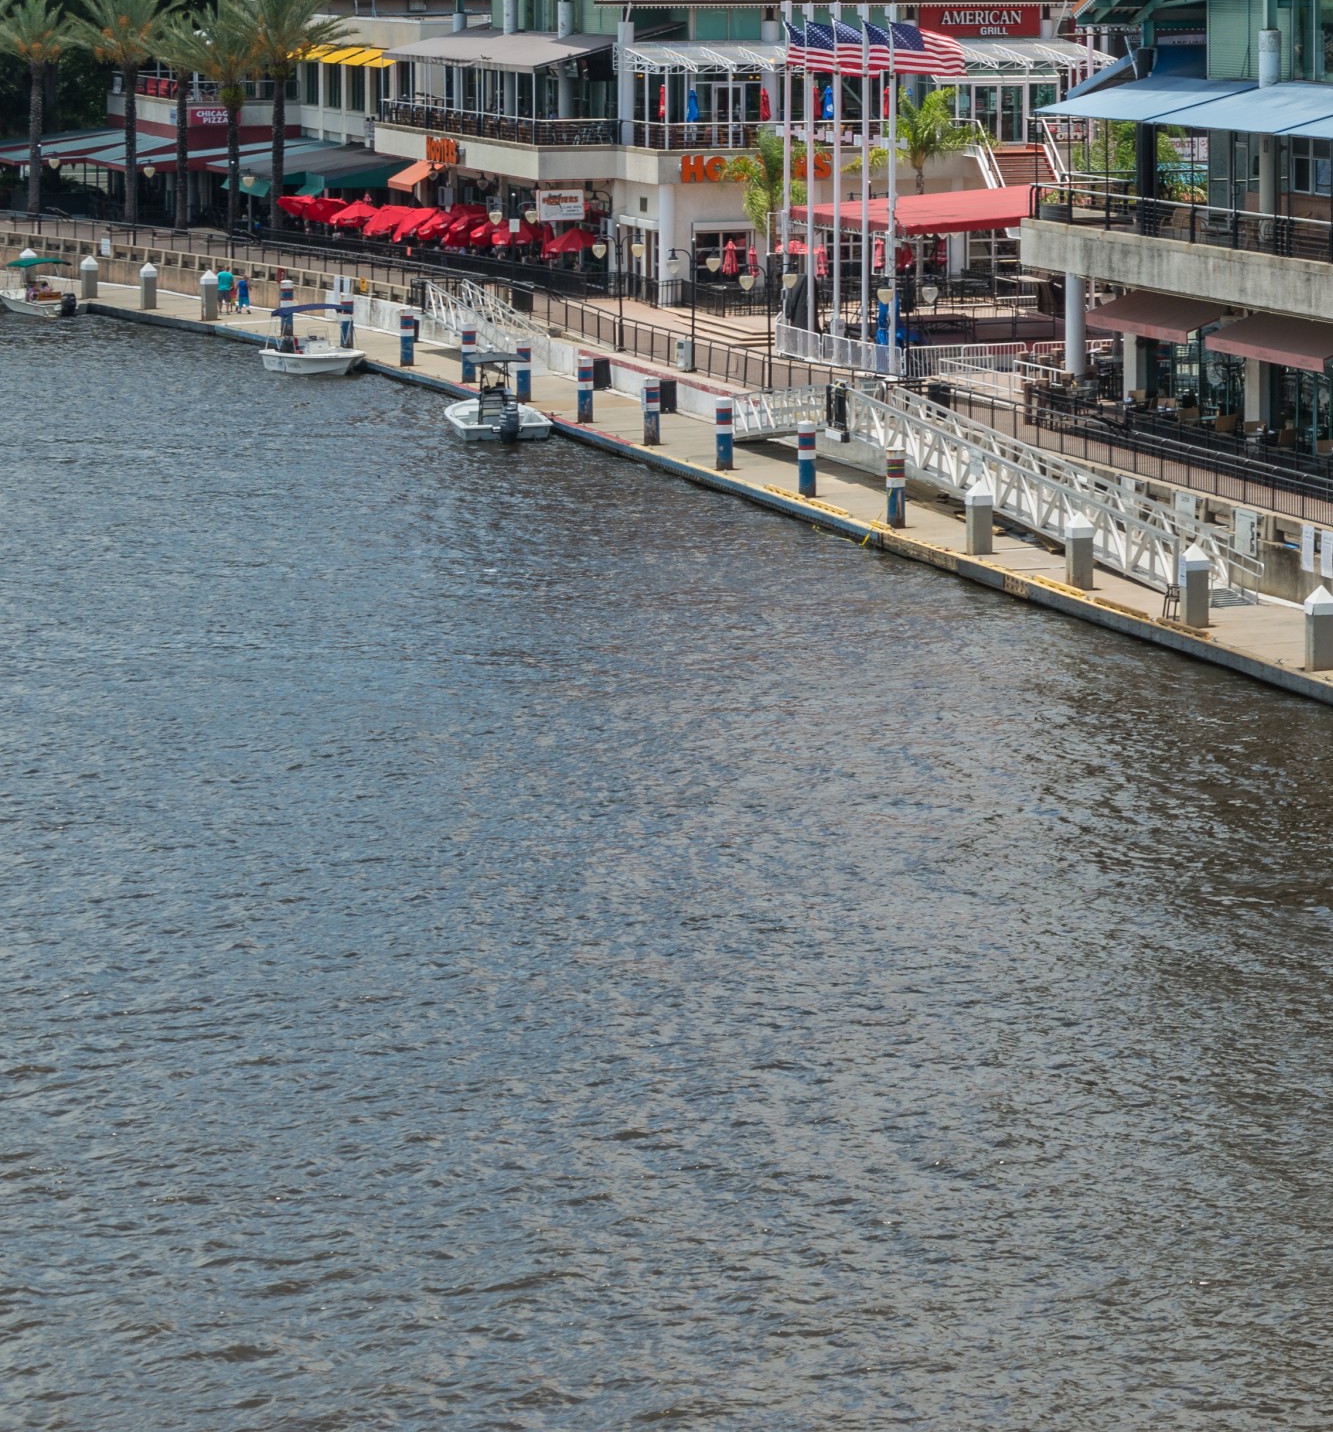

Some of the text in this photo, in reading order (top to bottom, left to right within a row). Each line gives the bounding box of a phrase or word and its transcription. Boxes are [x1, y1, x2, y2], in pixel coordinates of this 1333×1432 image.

[941, 10, 1022, 25] AMERICAN
[980, 26, 1008, 35] GRILL
[426, 136, 458, 165] HOOTERS
